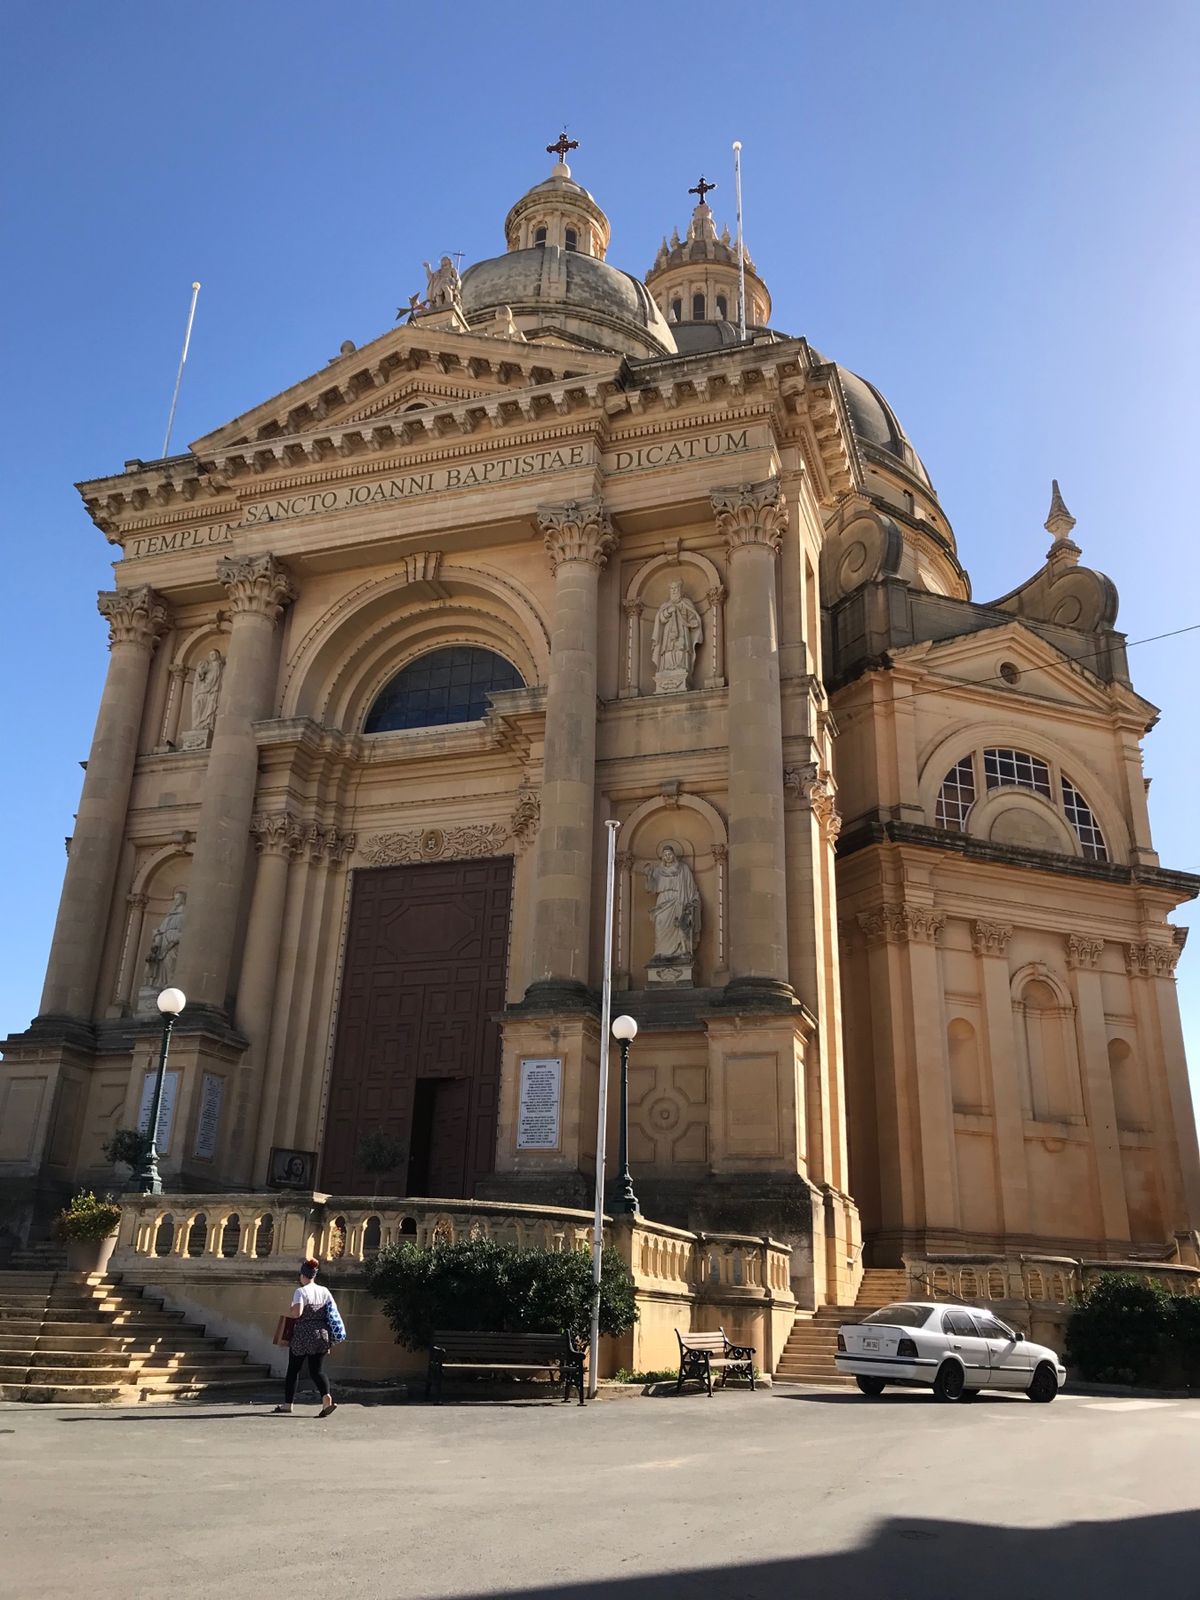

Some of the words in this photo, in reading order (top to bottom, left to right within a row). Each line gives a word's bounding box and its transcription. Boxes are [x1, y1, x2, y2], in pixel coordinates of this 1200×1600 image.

[245, 491, 338, 523] SANCTO
[345, 473, 435, 505] JOANNI
[446, 445, 585, 487] BAPTISTAE
[615, 429, 750, 471] DICATUM
